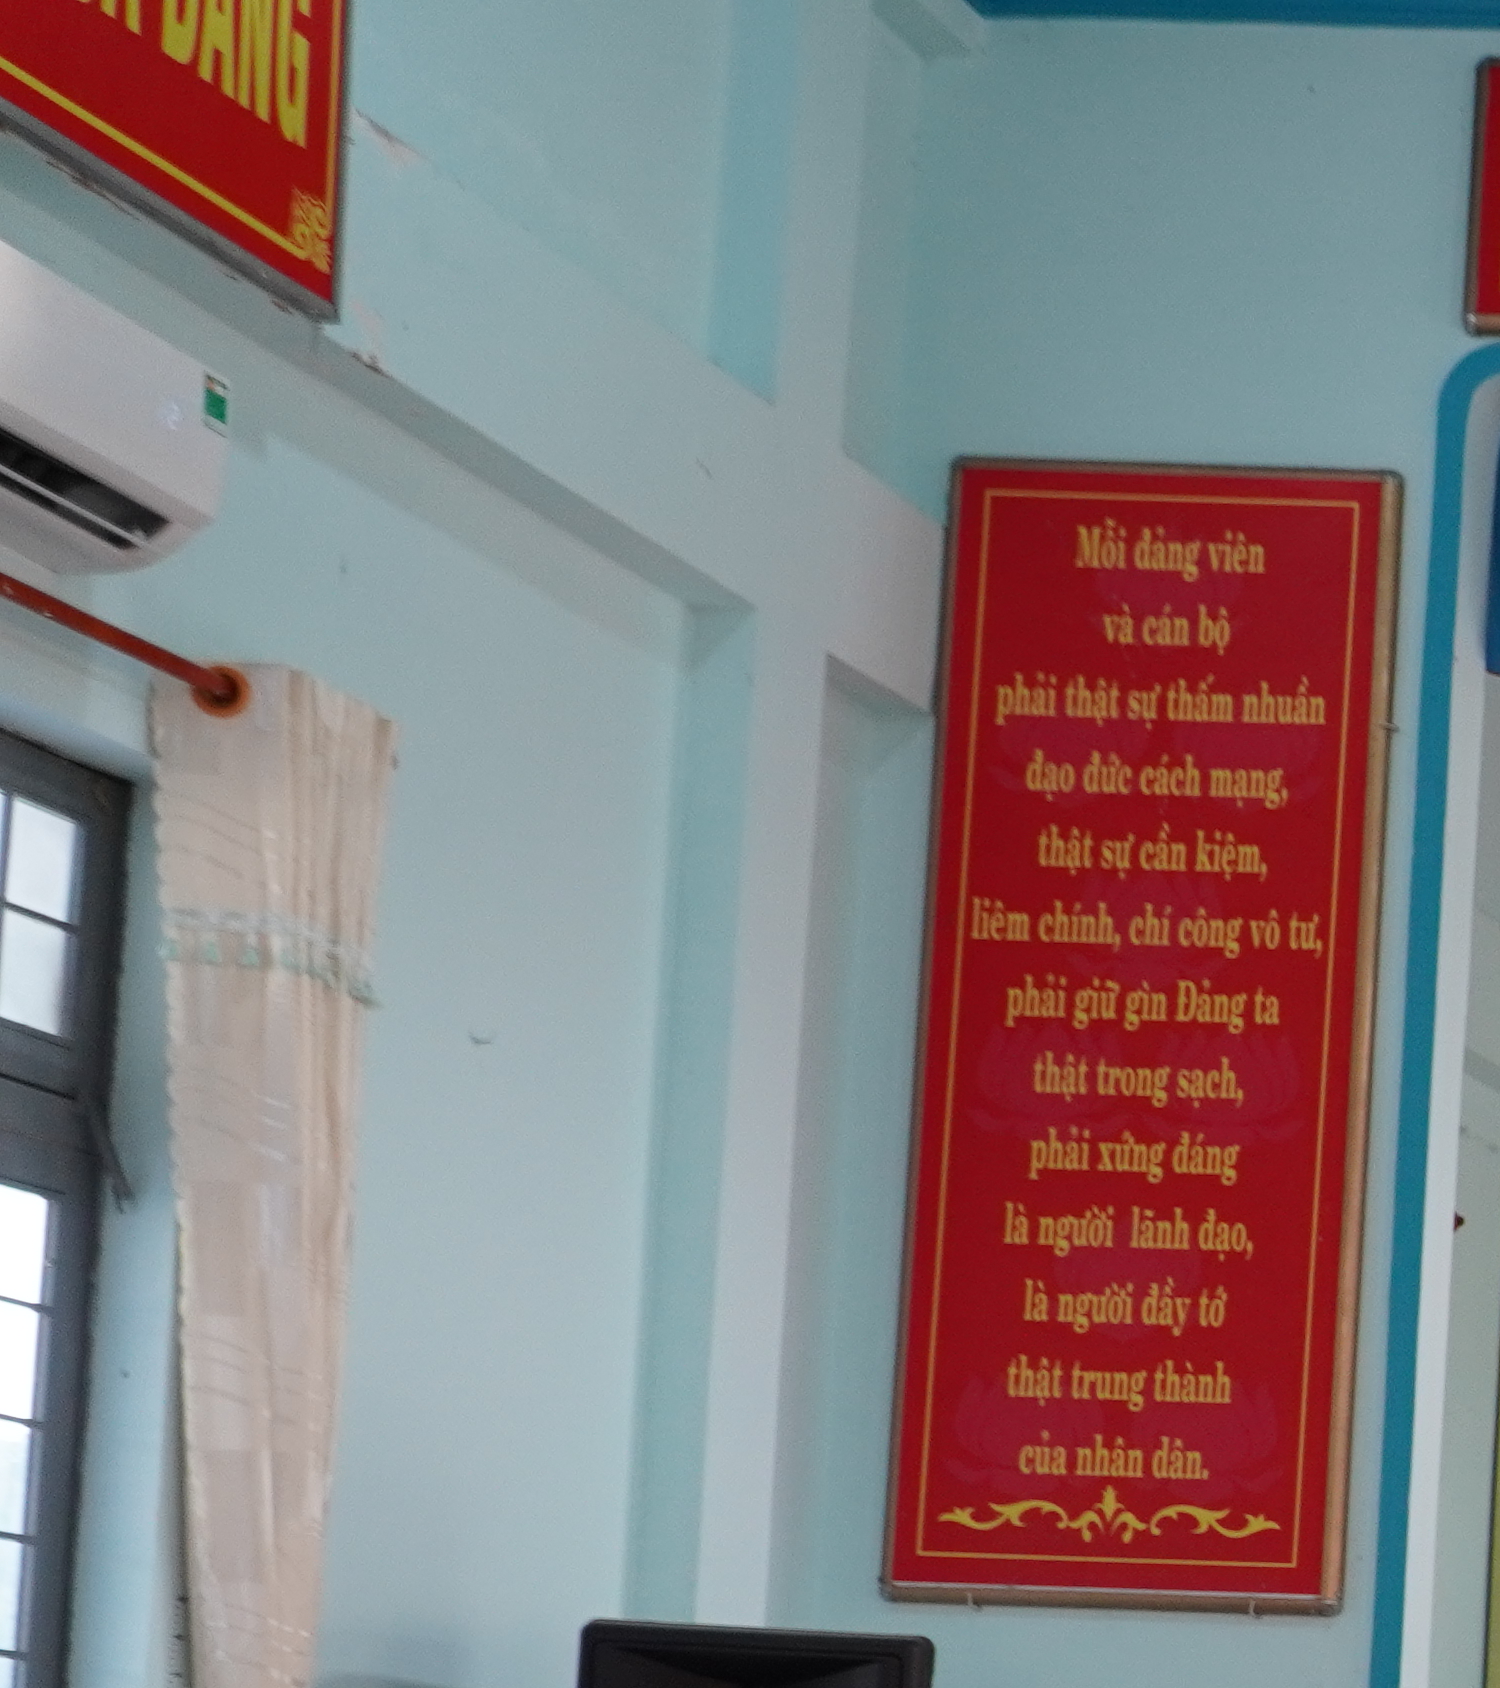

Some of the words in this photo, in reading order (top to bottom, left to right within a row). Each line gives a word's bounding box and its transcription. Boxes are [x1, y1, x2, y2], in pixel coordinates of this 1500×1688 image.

[1075, 517, 1127, 569] Mỗi
[1133, 526, 1202, 582] đảng
[1207, 530, 1265, 573] viên
[1102, 603, 1136, 645] và
[1198, 604, 1231, 655] bộ
[995, 672, 1057, 725] phải
[1065, 675, 1120, 726] thật
[1127, 683, 1162, 729] sự
[1167, 674, 1234, 723] thấm
[1025, 748, 1076, 801] đạo
[1082, 750, 1133, 795] đức
[1139, 754, 1201, 797] cách
[1209, 768, 1289, 809] mạng,
[1038, 824, 1094, 875] thật
[1100, 833, 1135, 879] sự
[1195, 829, 1267, 881] kiệm,
[970, 897, 1030, 941] liêm
[1038, 900, 1121, 952] chính,
[1128, 902, 1172, 946] chí
[1177, 907, 1243, 959] công
[1249, 909, 1281, 949] vô
[1289, 913, 1323, 958] tư,
[1005, 973, 1067, 1027] phải
[1072, 977, 1120, 1030] giữ
[1124, 981, 1167, 1031] gìn
[1175, 979, 1247, 1034] Đảng
[1254, 987, 1280, 1025] ta
[1033, 1051, 1089, 1102] thật
[1096, 1059, 1171, 1108] trong
[1176, 1056, 1244, 1108] sạch,
[1028, 1125, 1090, 1180] phải
[1097, 1131, 1166, 1184] xứng
[1172, 1131, 1240, 1186] đáng
[1003, 1201, 1029, 1245] là
[1037, 1205, 1114, 1257] người
[1130, 1206, 1190, 1250] lãnh
[1198, 1208, 1253, 1261] đạo,
[1023, 1278, 1049, 1322] là
[1057, 1282, 1134, 1333] người
[1007, 1354, 1063, 1406] thật
[1071, 1362, 1147, 1412] trung
[1154, 1360, 1231, 1404] thành
[1018, 1430, 1067, 1475] của
[1075, 1434, 1143, 1478] nhân
[1152, 1436, 1209, 1480] dân.
